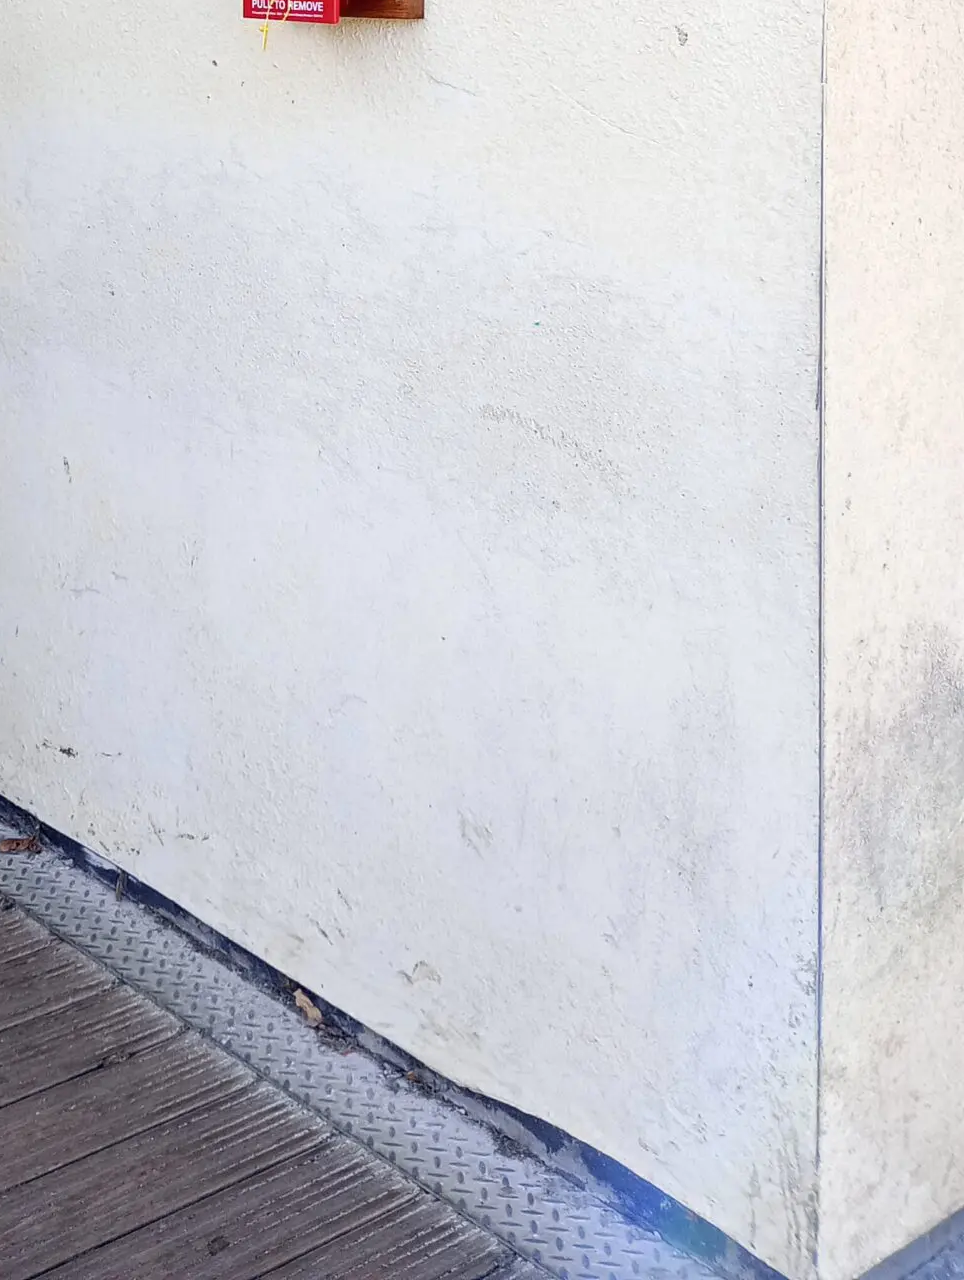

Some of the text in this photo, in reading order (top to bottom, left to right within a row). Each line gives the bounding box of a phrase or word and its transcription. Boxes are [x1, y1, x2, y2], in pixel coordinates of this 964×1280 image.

[252, 0, 324, 12] PULL TO REMOVE
